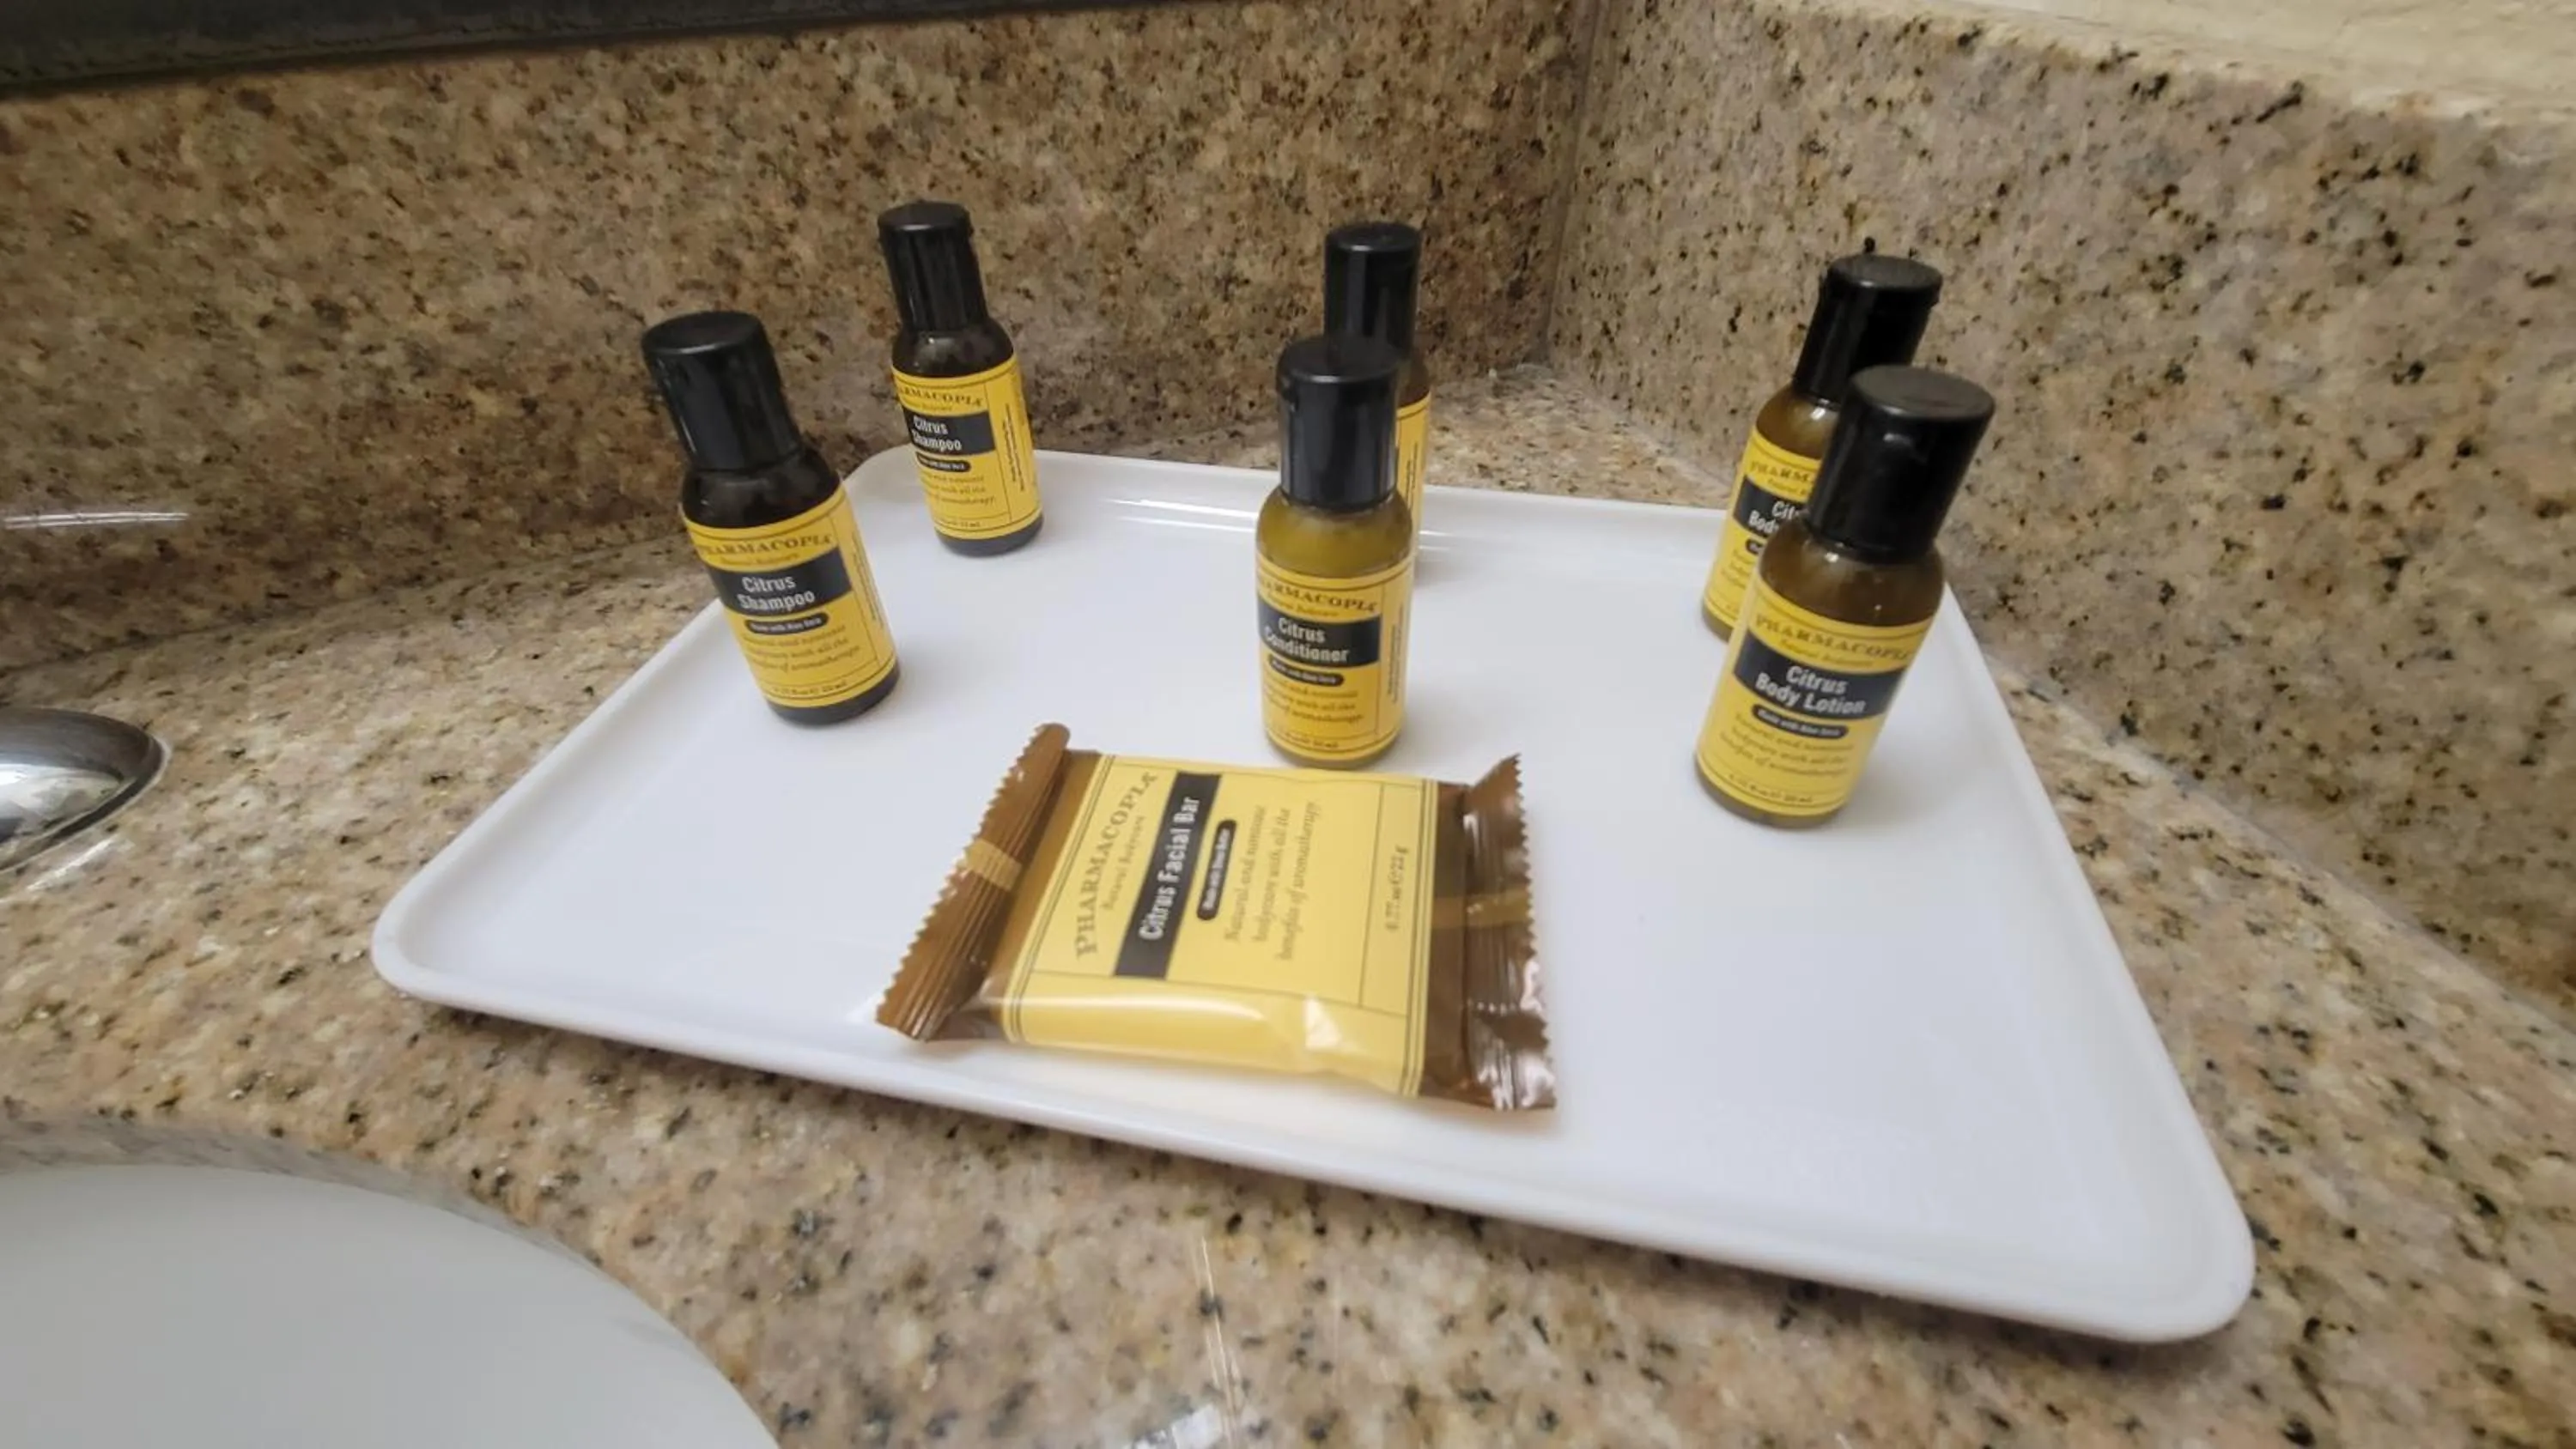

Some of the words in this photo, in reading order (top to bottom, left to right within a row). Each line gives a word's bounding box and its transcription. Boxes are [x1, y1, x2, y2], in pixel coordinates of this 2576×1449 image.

[741, 575, 797, 593] Citrus
[737, 590, 816, 613] Shampoo
[1264, 626, 1350, 663] Conditioner
[1278, 616, 1326, 643] Citrus
[1754, 672, 1801, 708] Body
[1804, 694, 1866, 714] Lotion
[1786, 665, 1849, 694] Citrus
[1173, 796, 1200, 825] Bar
[1075, 771, 1157, 959] PHARMACOPIA
[1157, 828, 1193, 883] Facial
[1138, 885, 1177, 941] Citrus
